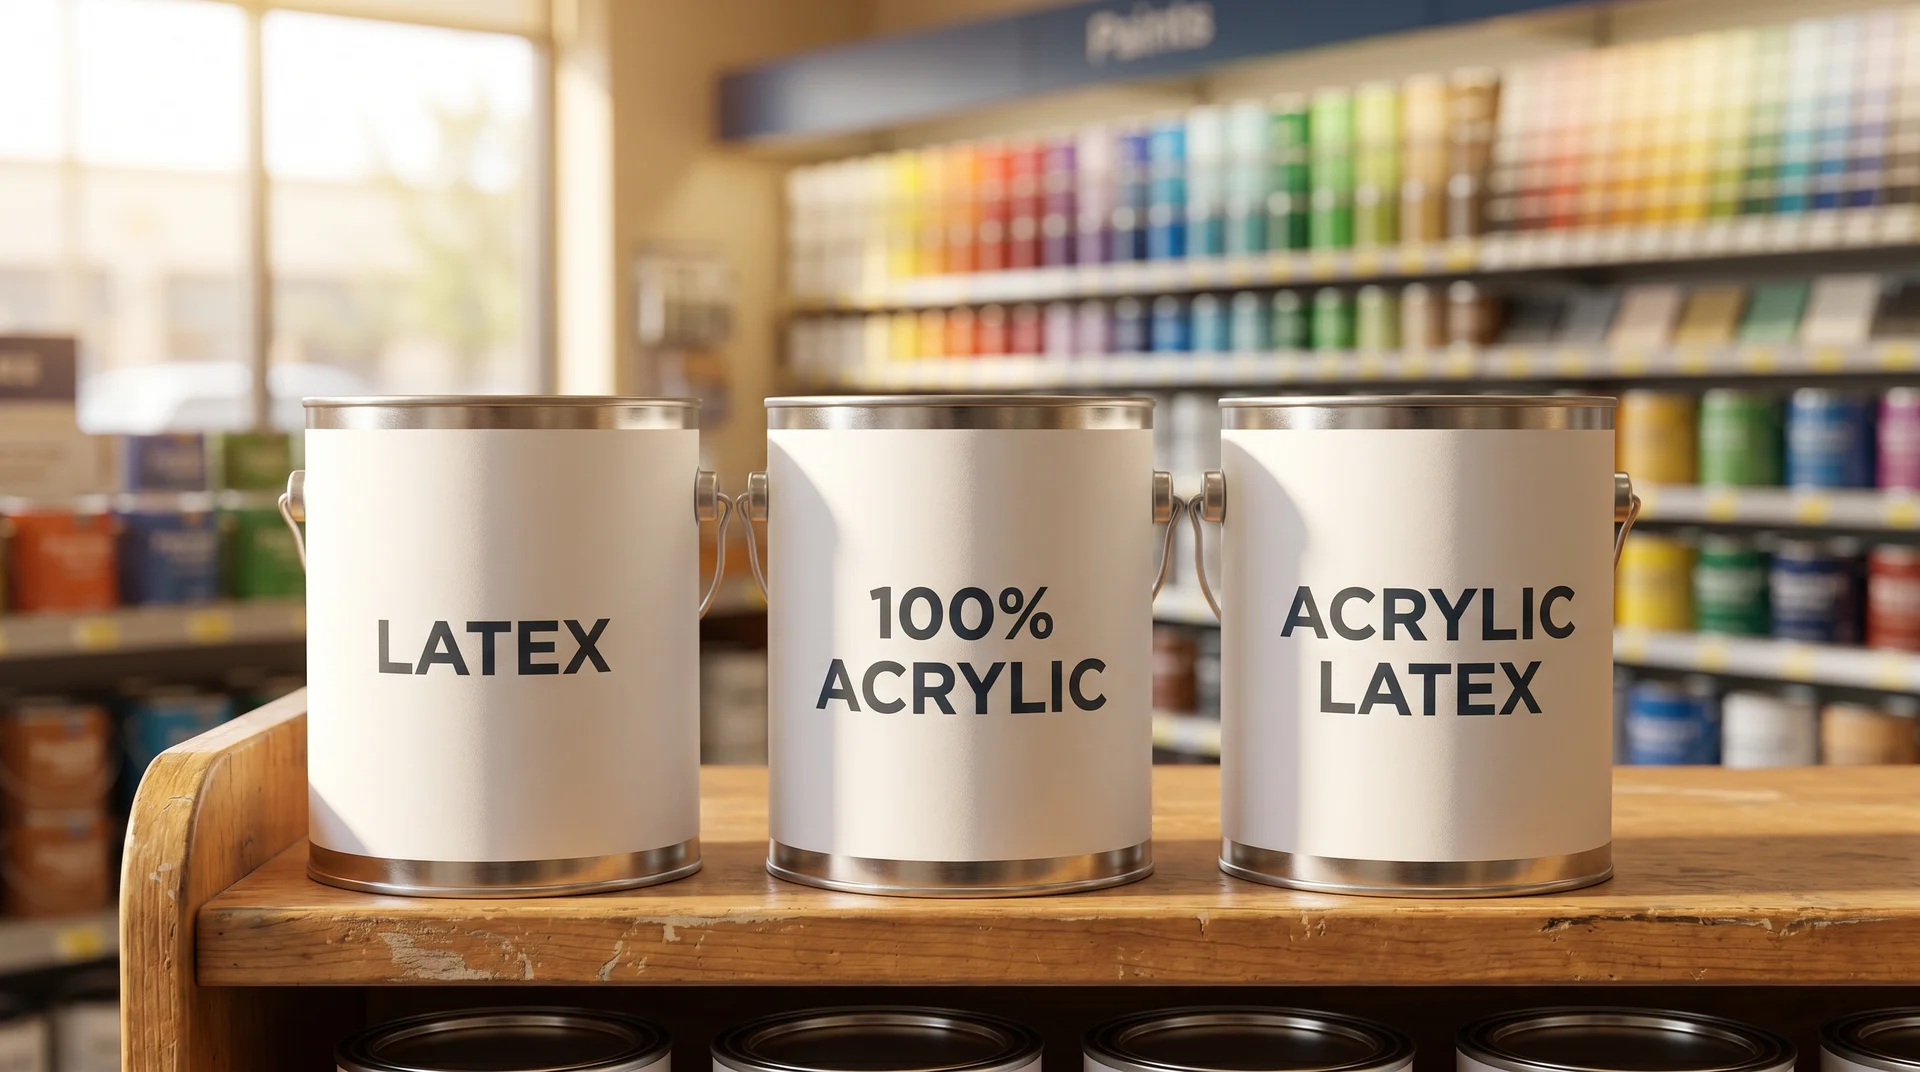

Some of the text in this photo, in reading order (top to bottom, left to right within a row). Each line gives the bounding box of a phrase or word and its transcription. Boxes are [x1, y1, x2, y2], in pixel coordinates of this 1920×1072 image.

[1087, 2, 1215, 66] Paints
[870, 587, 1053, 640] 100%
[1281, 586, 1575, 641] ACRYLIC
[379, 618, 611, 675] LATEX
[816, 658, 1106, 714] ACRYLIC
[1321, 661, 1542, 715] LATEX
